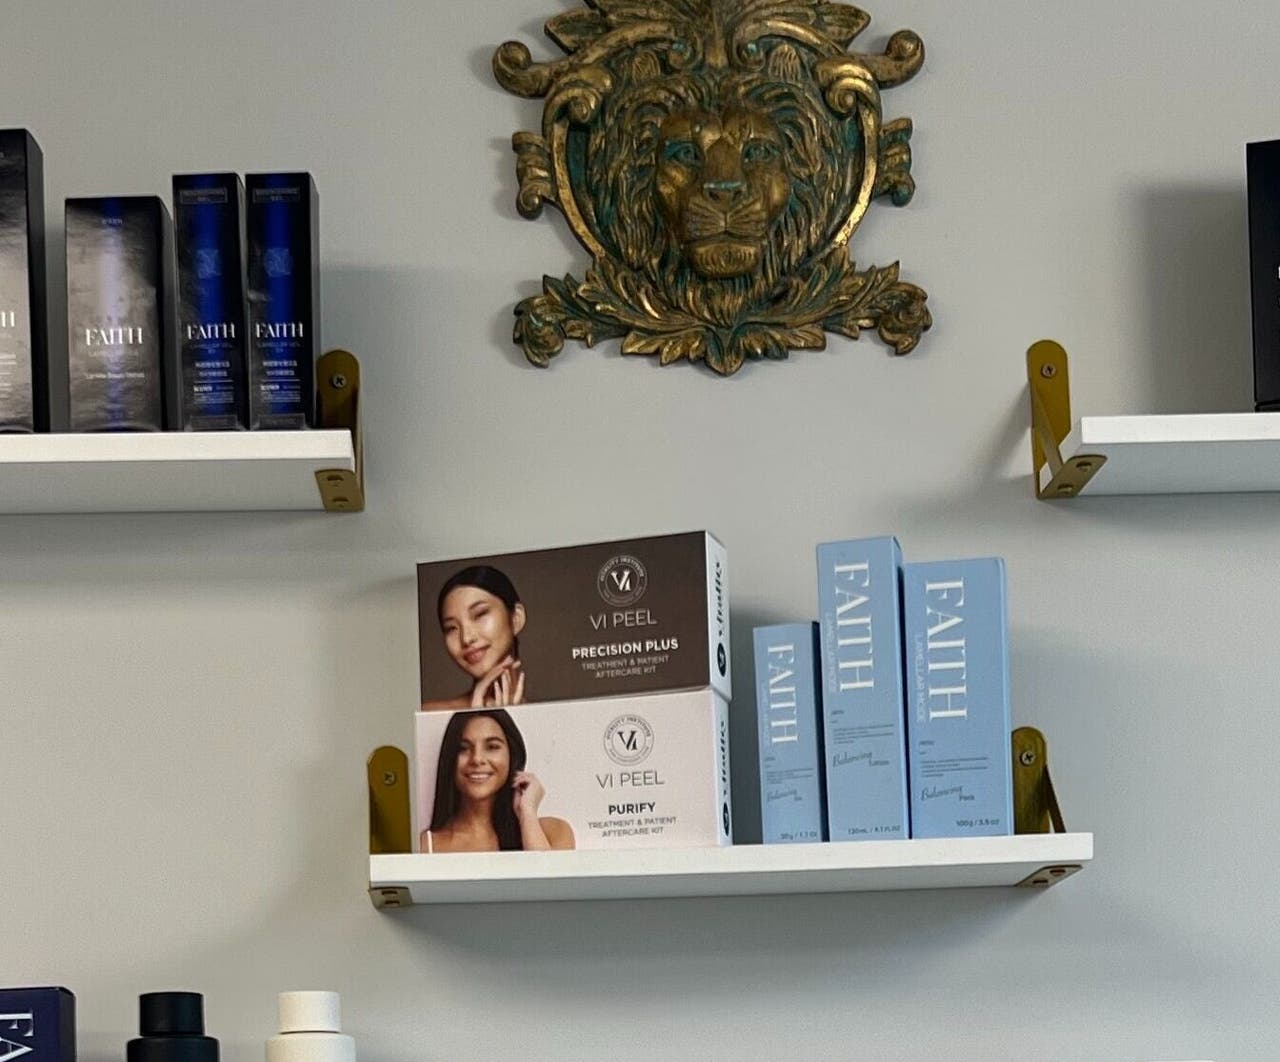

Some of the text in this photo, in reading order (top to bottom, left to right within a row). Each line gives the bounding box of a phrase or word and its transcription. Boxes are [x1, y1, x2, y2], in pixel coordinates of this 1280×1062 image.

[85, 327, 143, 346] FAITH
[187, 323, 235, 340] FAITH
[255, 322, 303, 338] FAITH
[590, 608, 657, 631] VI PEEL
[834, 560, 874, 692] FAITH
[572, 637, 679, 660] PRECISION PLUS
[926, 577, 968, 721] FAITH
[581, 659, 628, 671] TREATMENT
[637, 655, 669, 666] PATIENT
[644, 665, 657, 674] KIT
[768, 644, 799, 743] FAITH
[596, 770, 665, 789] VI PEEL
[608, 801, 656, 816] PURIFY
[588, 819, 634, 830] TREATMENT
[644, 816, 676, 826] PATIENT
[651, 826, 664, 834] KIT
